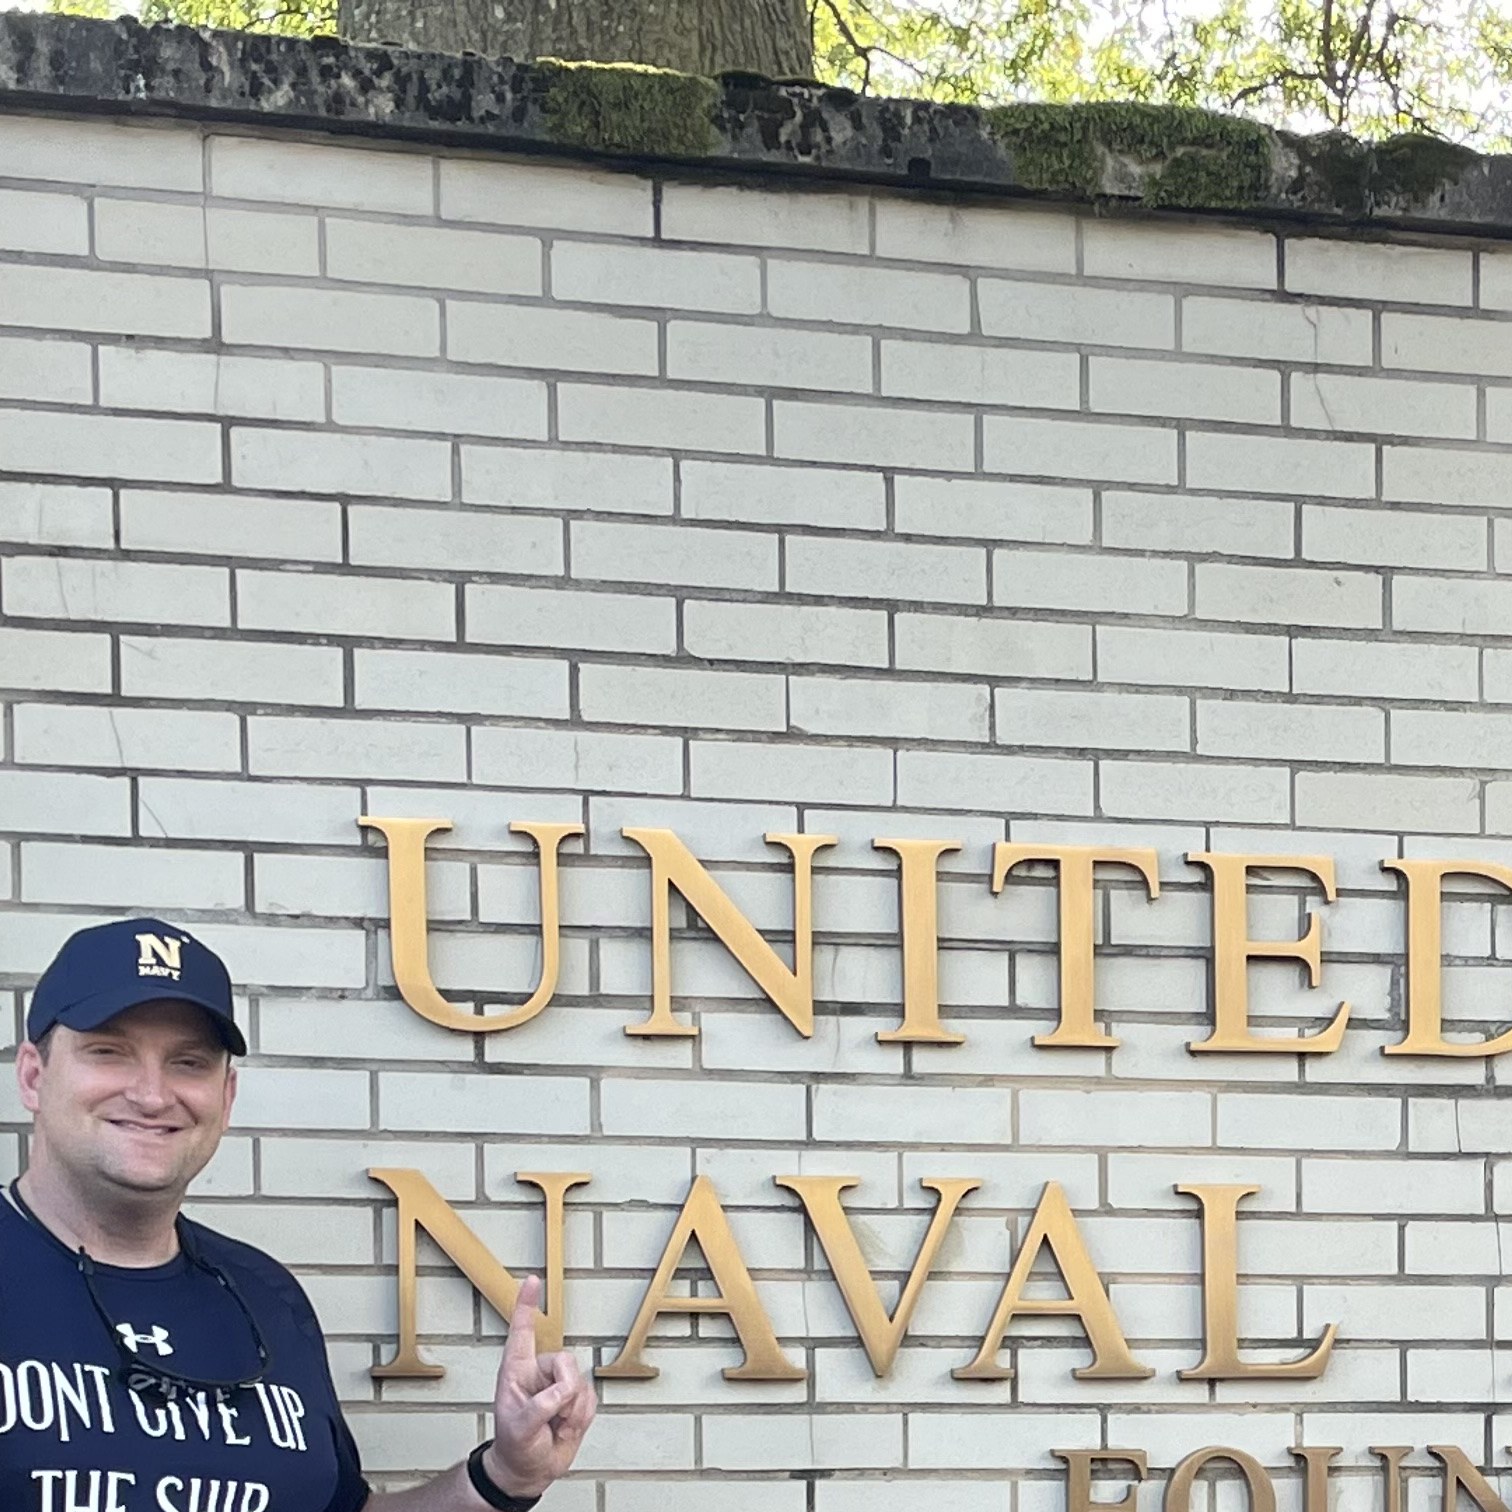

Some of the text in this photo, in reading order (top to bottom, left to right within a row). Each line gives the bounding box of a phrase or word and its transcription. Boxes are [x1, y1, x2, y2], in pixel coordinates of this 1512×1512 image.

[134, 932, 182, 969] N
[366, 1167, 1339, 1381] NAVAL
[254, 1382, 307, 1451] UP
